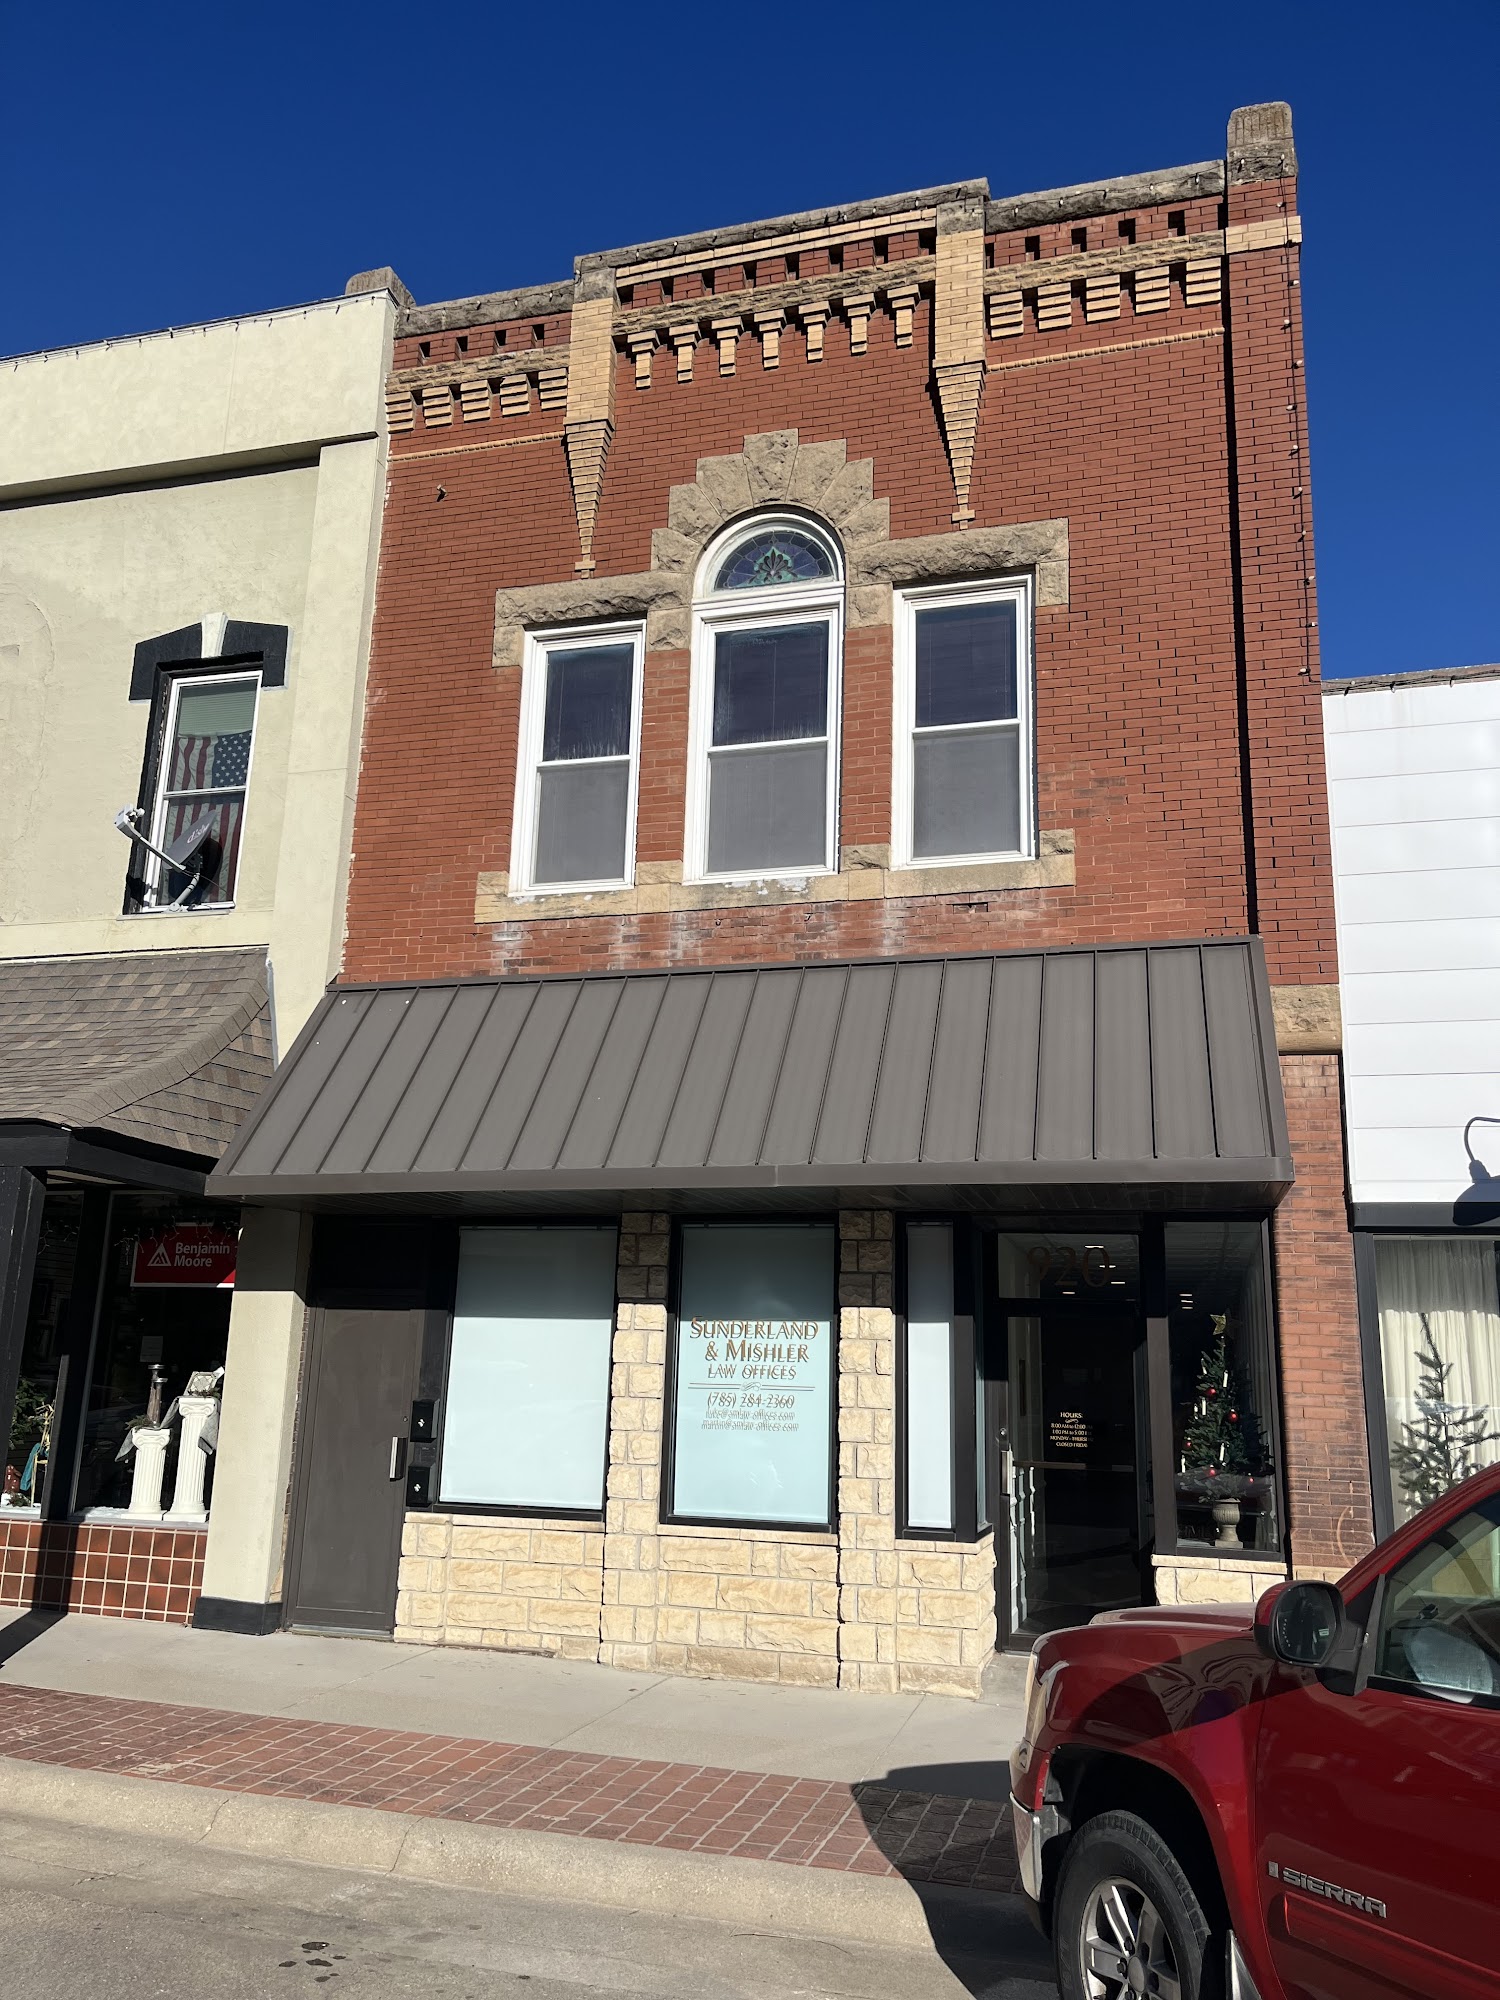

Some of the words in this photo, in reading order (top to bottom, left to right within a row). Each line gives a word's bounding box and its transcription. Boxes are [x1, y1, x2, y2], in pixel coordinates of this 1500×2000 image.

[175, 1242, 230, 1257] Benjamin
[174, 1255, 212, 1267] Moore
[1027, 1245, 1110, 1288] 920
[690, 1317, 819, 1340] SUNDERLAND
[705, 1341, 719, 1361] &
[725, 1339, 809, 1362] MISHLER
[708, 1363, 737, 1379] LAW
[742, 1363, 797, 1380] OFFICES
[707, 1392, 737, 1409] (785)
[740, 1393, 795, 1409] 284-2360
[1283, 1867, 1386, 1918] SIERRA
